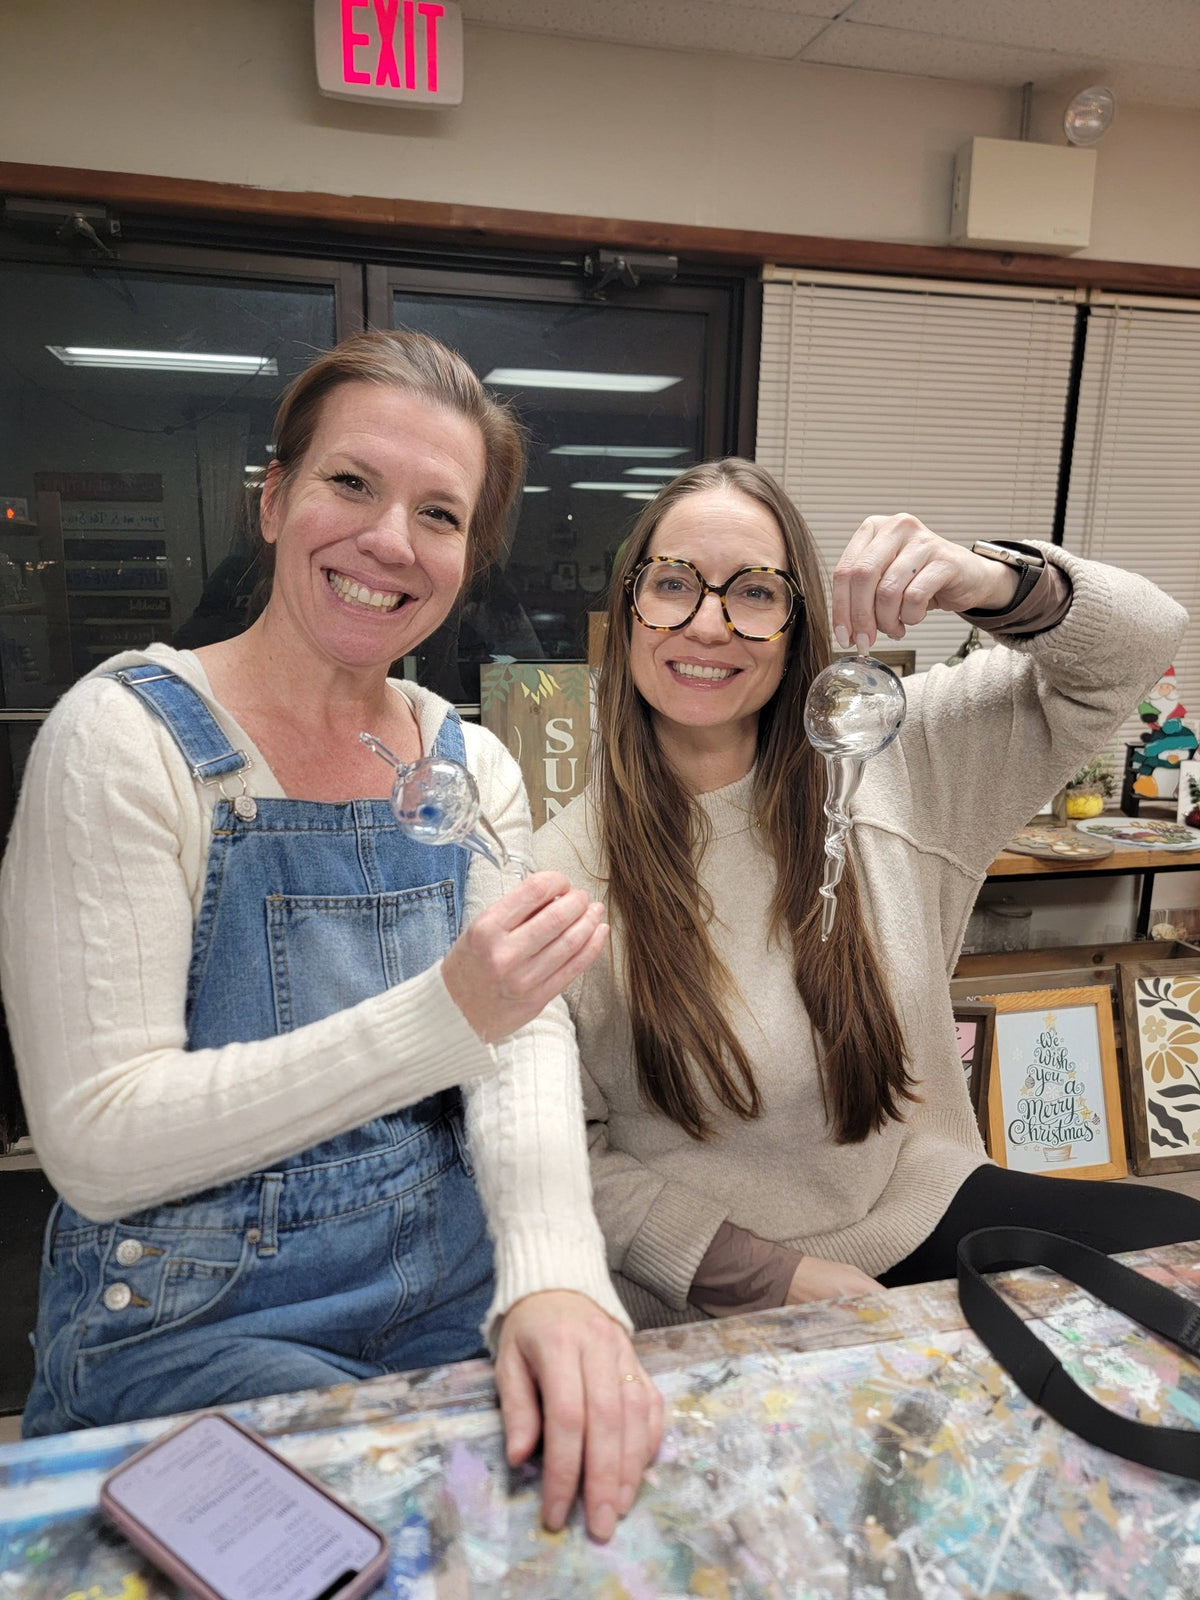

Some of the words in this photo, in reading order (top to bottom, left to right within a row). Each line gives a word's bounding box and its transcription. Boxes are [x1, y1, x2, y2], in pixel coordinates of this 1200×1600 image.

[341, 0, 445, 93] EXIT
[1037, 1029, 1060, 1048] We
[1064, 1080, 1085, 1095] a
[1017, 1096, 1076, 1125] Merry
[1008, 1117, 1093, 1145] Christmas
